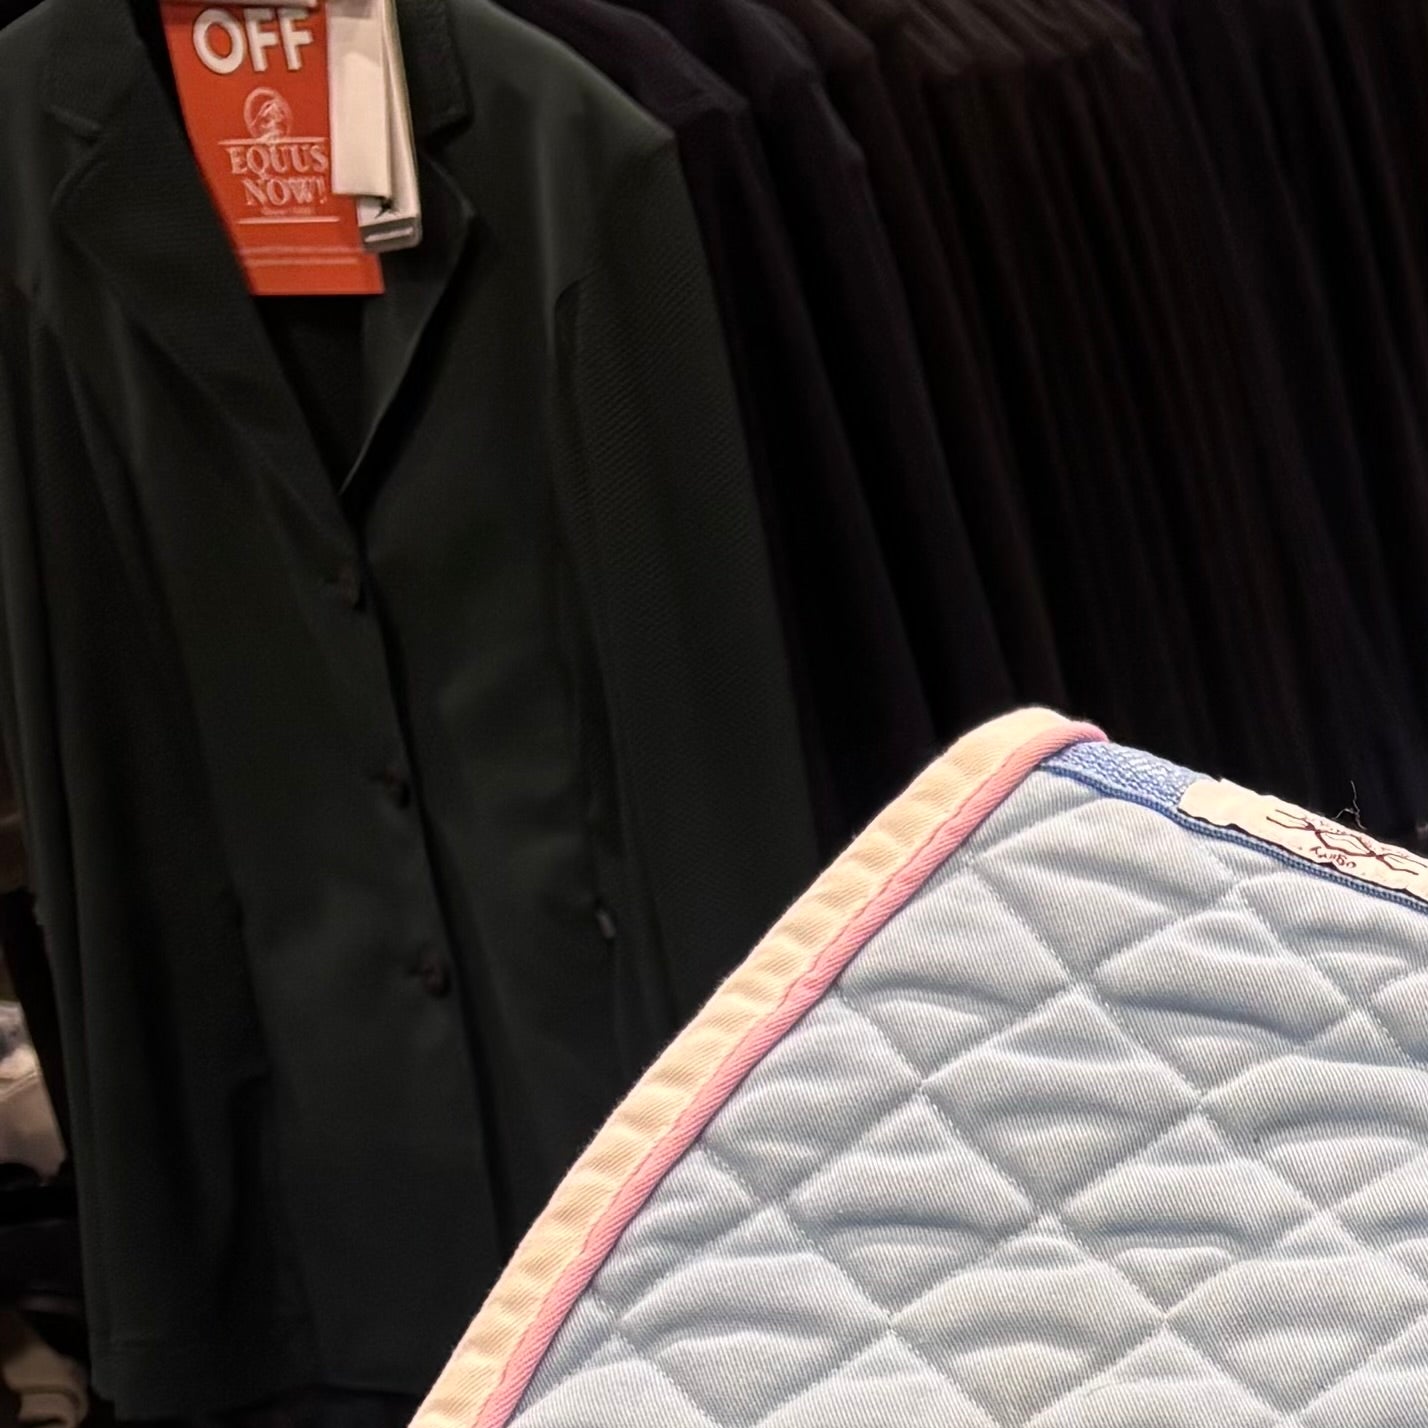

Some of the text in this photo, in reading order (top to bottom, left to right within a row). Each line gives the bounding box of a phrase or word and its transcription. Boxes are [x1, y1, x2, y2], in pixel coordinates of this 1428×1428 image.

[193, 8, 313, 74] OFF
[226, 143, 328, 182] EQUUS
[241, 178, 328, 206] NOW!
